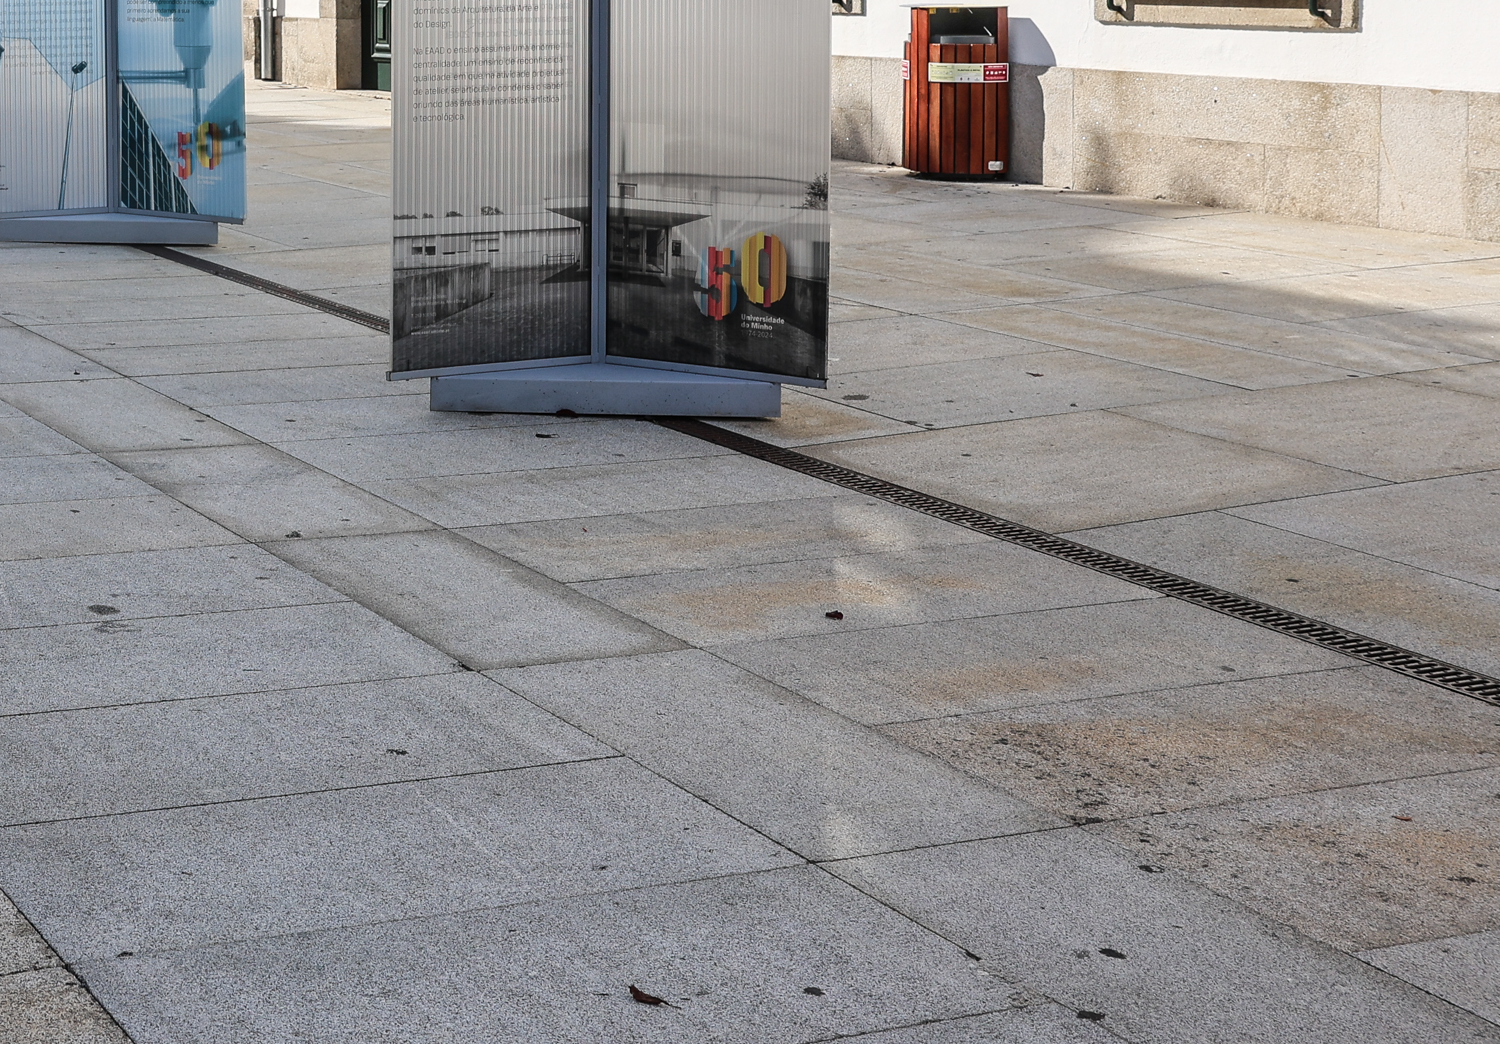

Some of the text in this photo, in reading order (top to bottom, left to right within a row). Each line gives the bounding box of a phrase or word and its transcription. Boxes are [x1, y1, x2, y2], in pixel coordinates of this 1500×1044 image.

[413, 6, 449, 15] domínios
[451, 6, 461, 14] da
[413, 21, 424, 29] do
[413, 47, 423, 55] Na
[424, 46, 445, 55] EAAD
[453, 46, 479, 54] ensino
[481, 45, 511, 53] assume
[413, 87, 423, 96] de
[445, 99, 458, 108] das
[173, 120, 222, 181] 50
[693, 231, 787, 321] 50
[741, 314, 785, 325] Universidade
[751, 322, 773, 331] Minho
